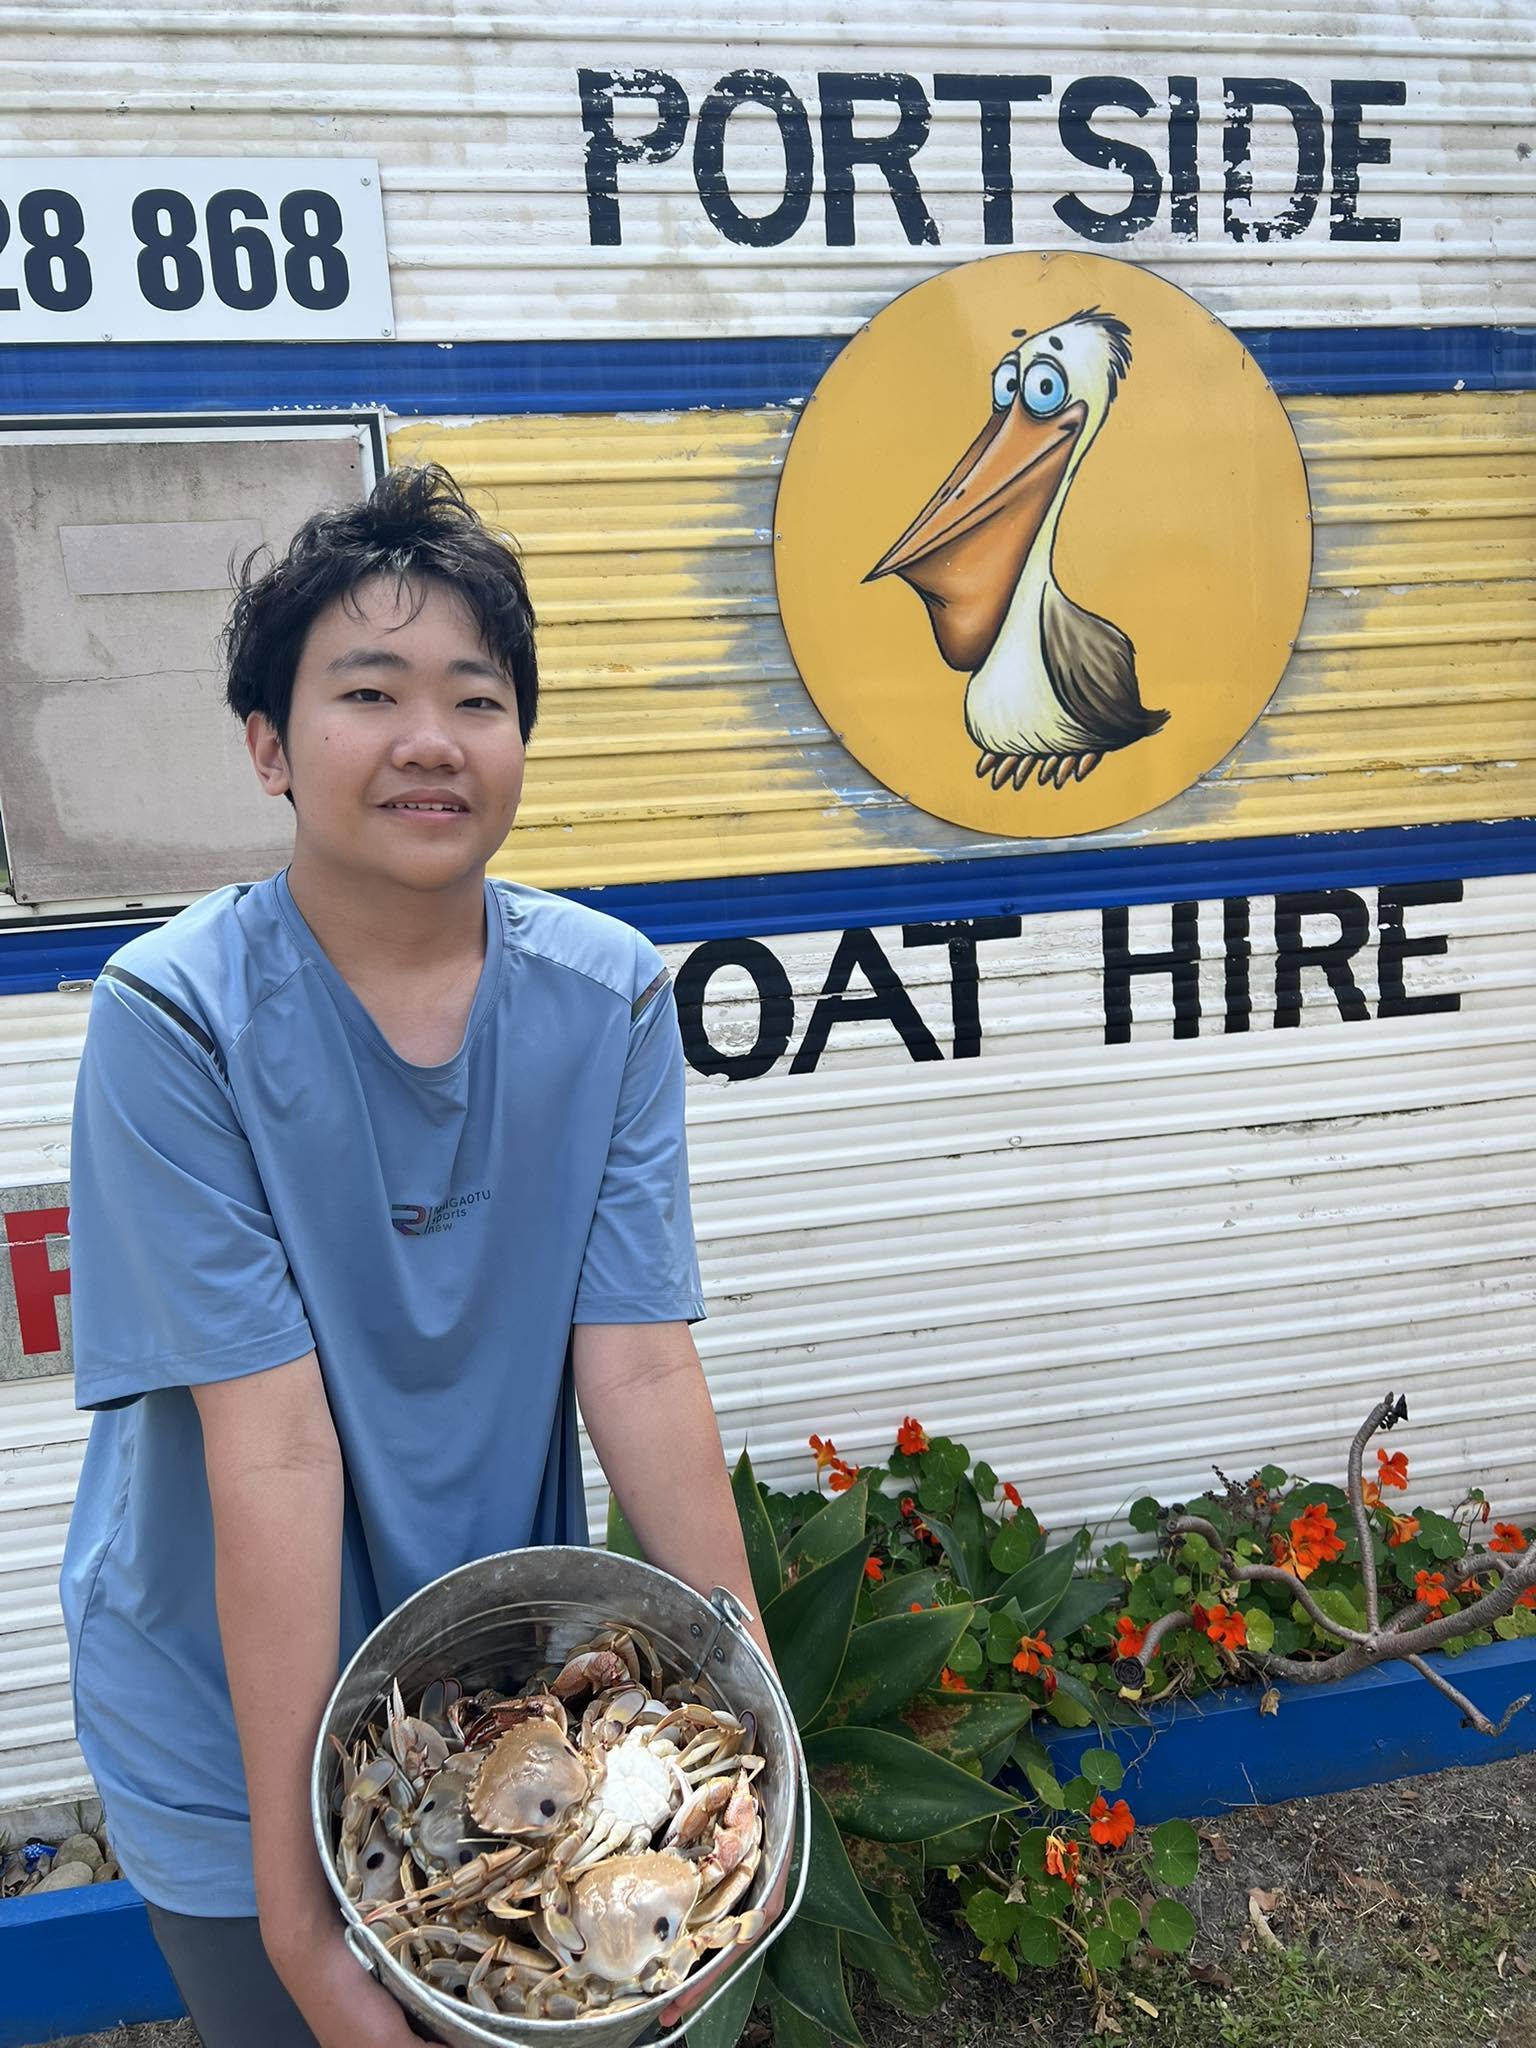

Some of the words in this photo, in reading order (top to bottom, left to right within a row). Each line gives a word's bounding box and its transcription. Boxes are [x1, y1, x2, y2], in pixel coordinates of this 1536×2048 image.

[576, 68, 1406, 247] PORTSIDE
[0, 188, 93, 312] 8
[131, 188, 350, 311] 868
[675, 916, 1022, 1082] OAT
[1102, 879, 1463, 1044] HIRE
[427, 1222, 453, 1234] new
[431, 1207, 467, 1225] sports
